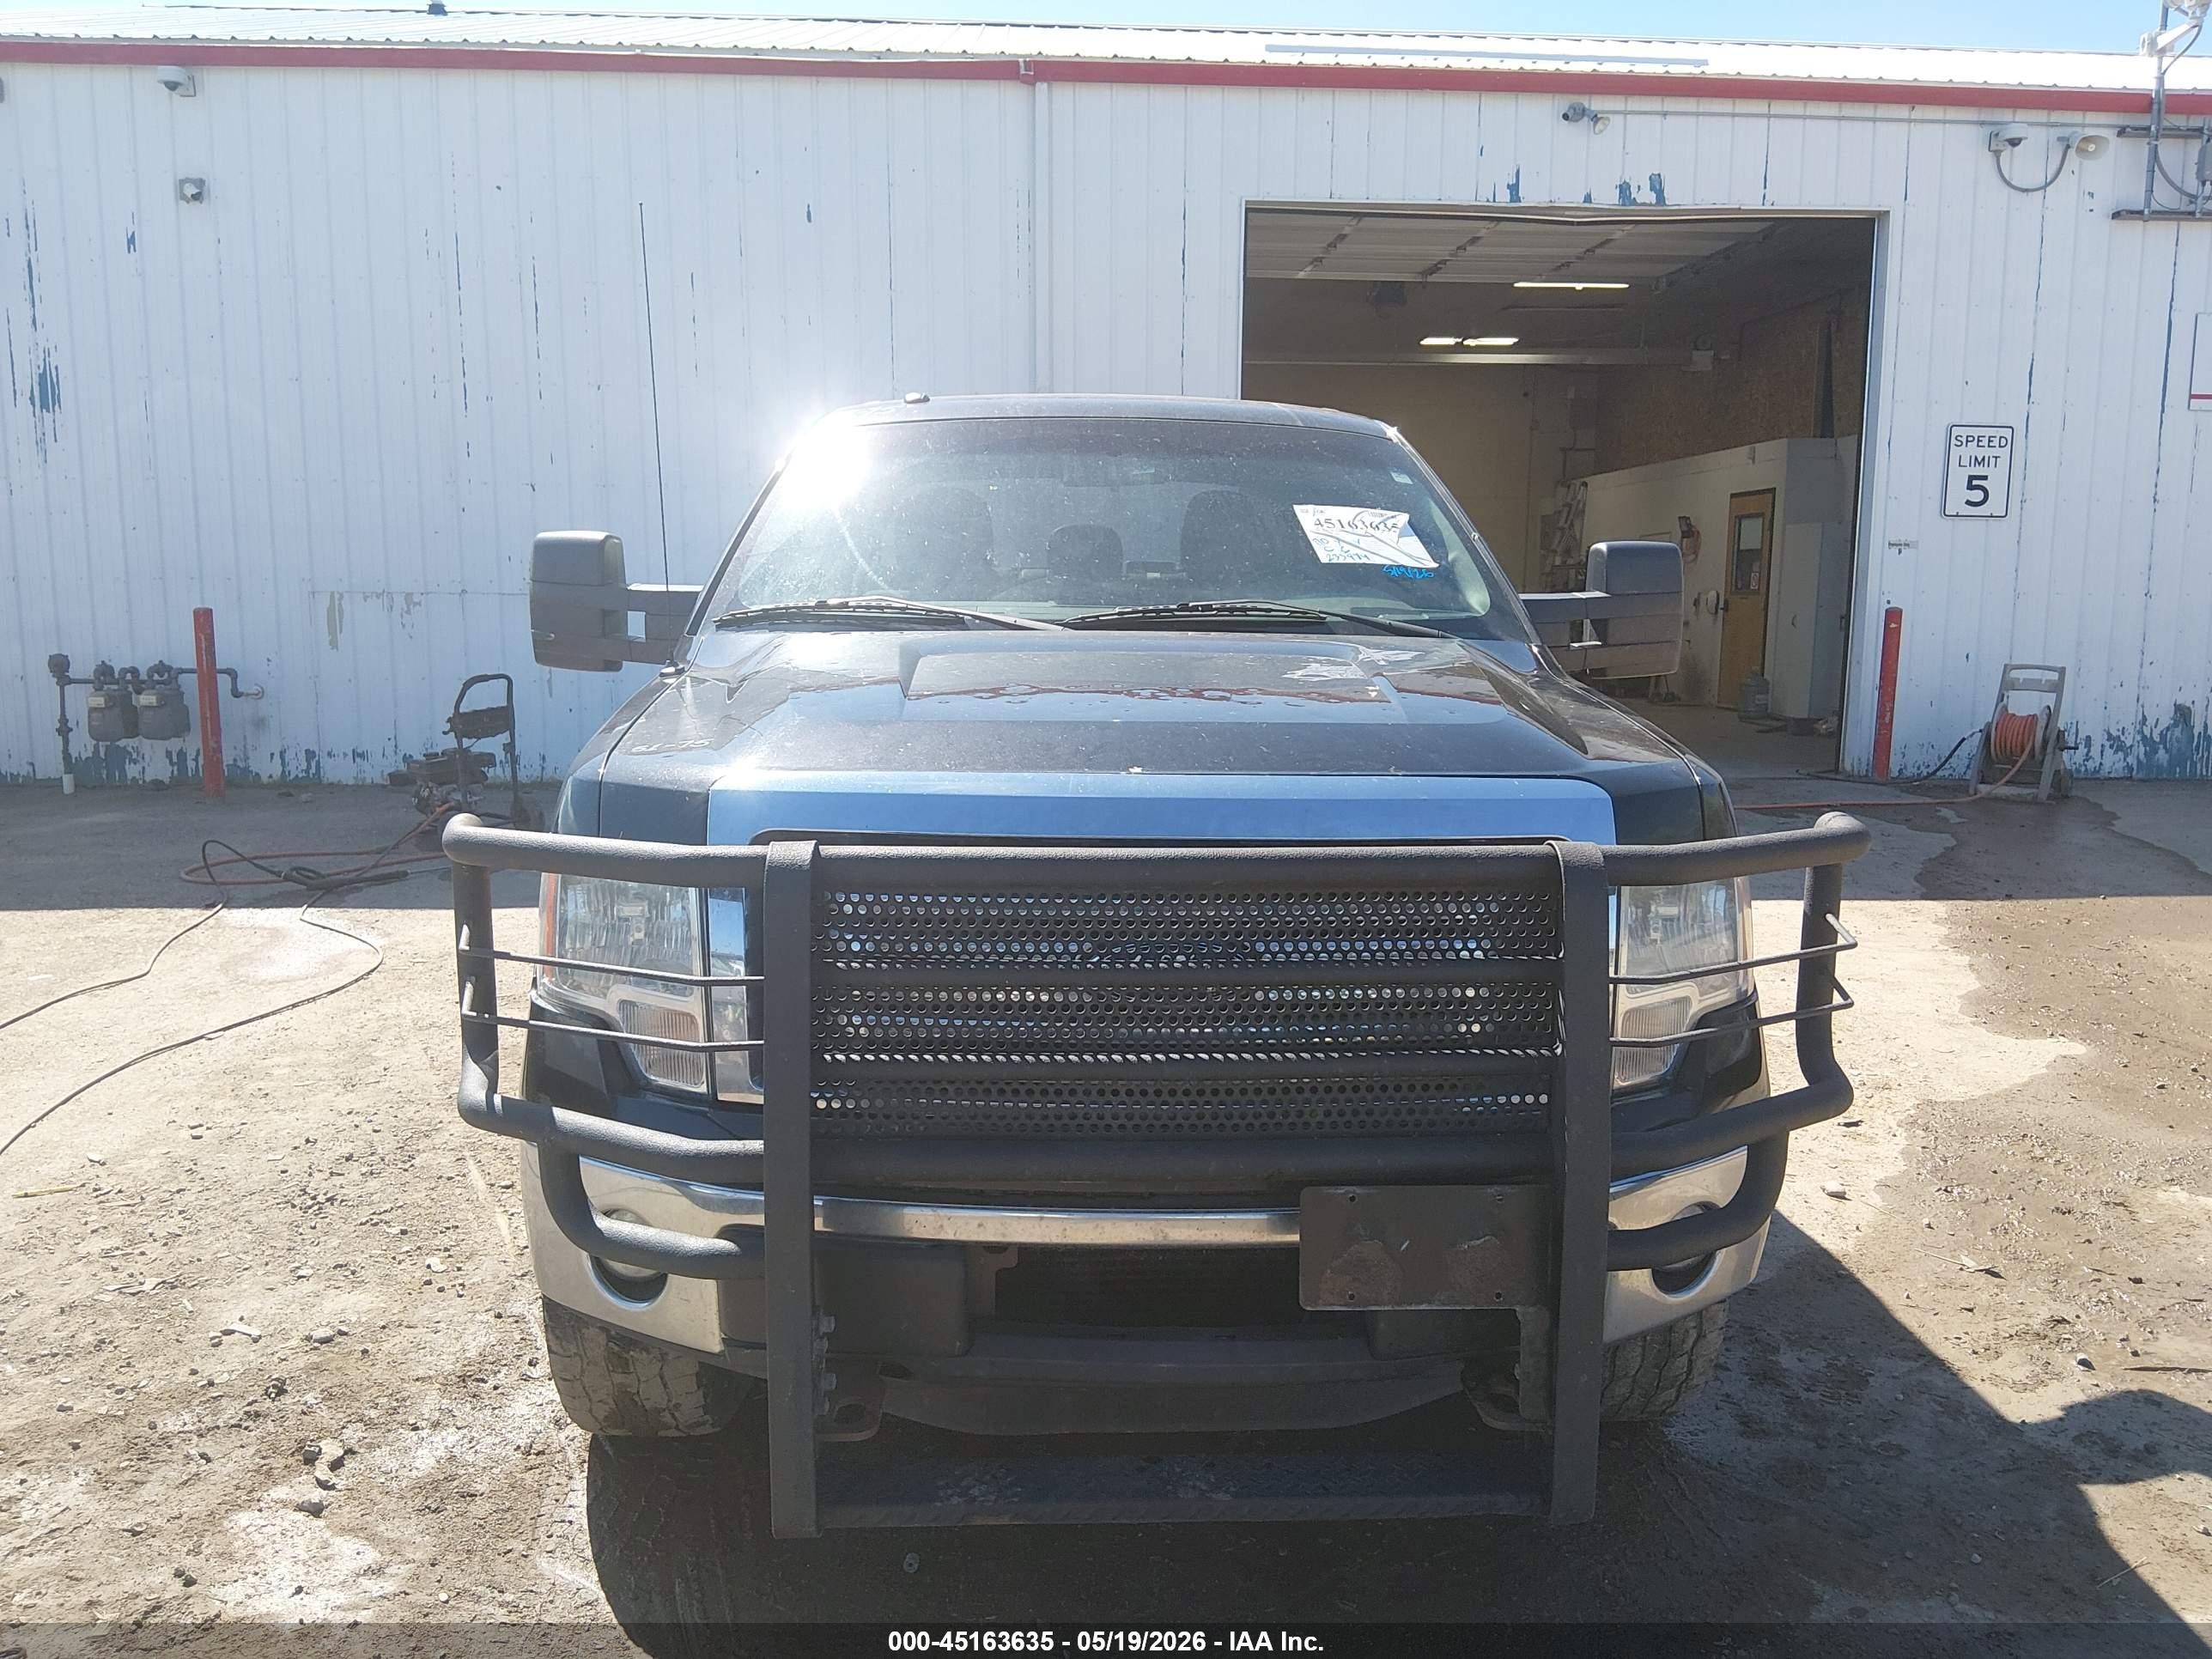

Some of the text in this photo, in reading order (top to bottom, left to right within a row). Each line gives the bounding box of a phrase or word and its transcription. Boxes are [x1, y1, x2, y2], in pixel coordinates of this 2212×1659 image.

[1954, 434, 2008, 448] SPEED
[1958, 454, 2002, 468] LIMIT
[1964, 474, 1990, 507] 5
